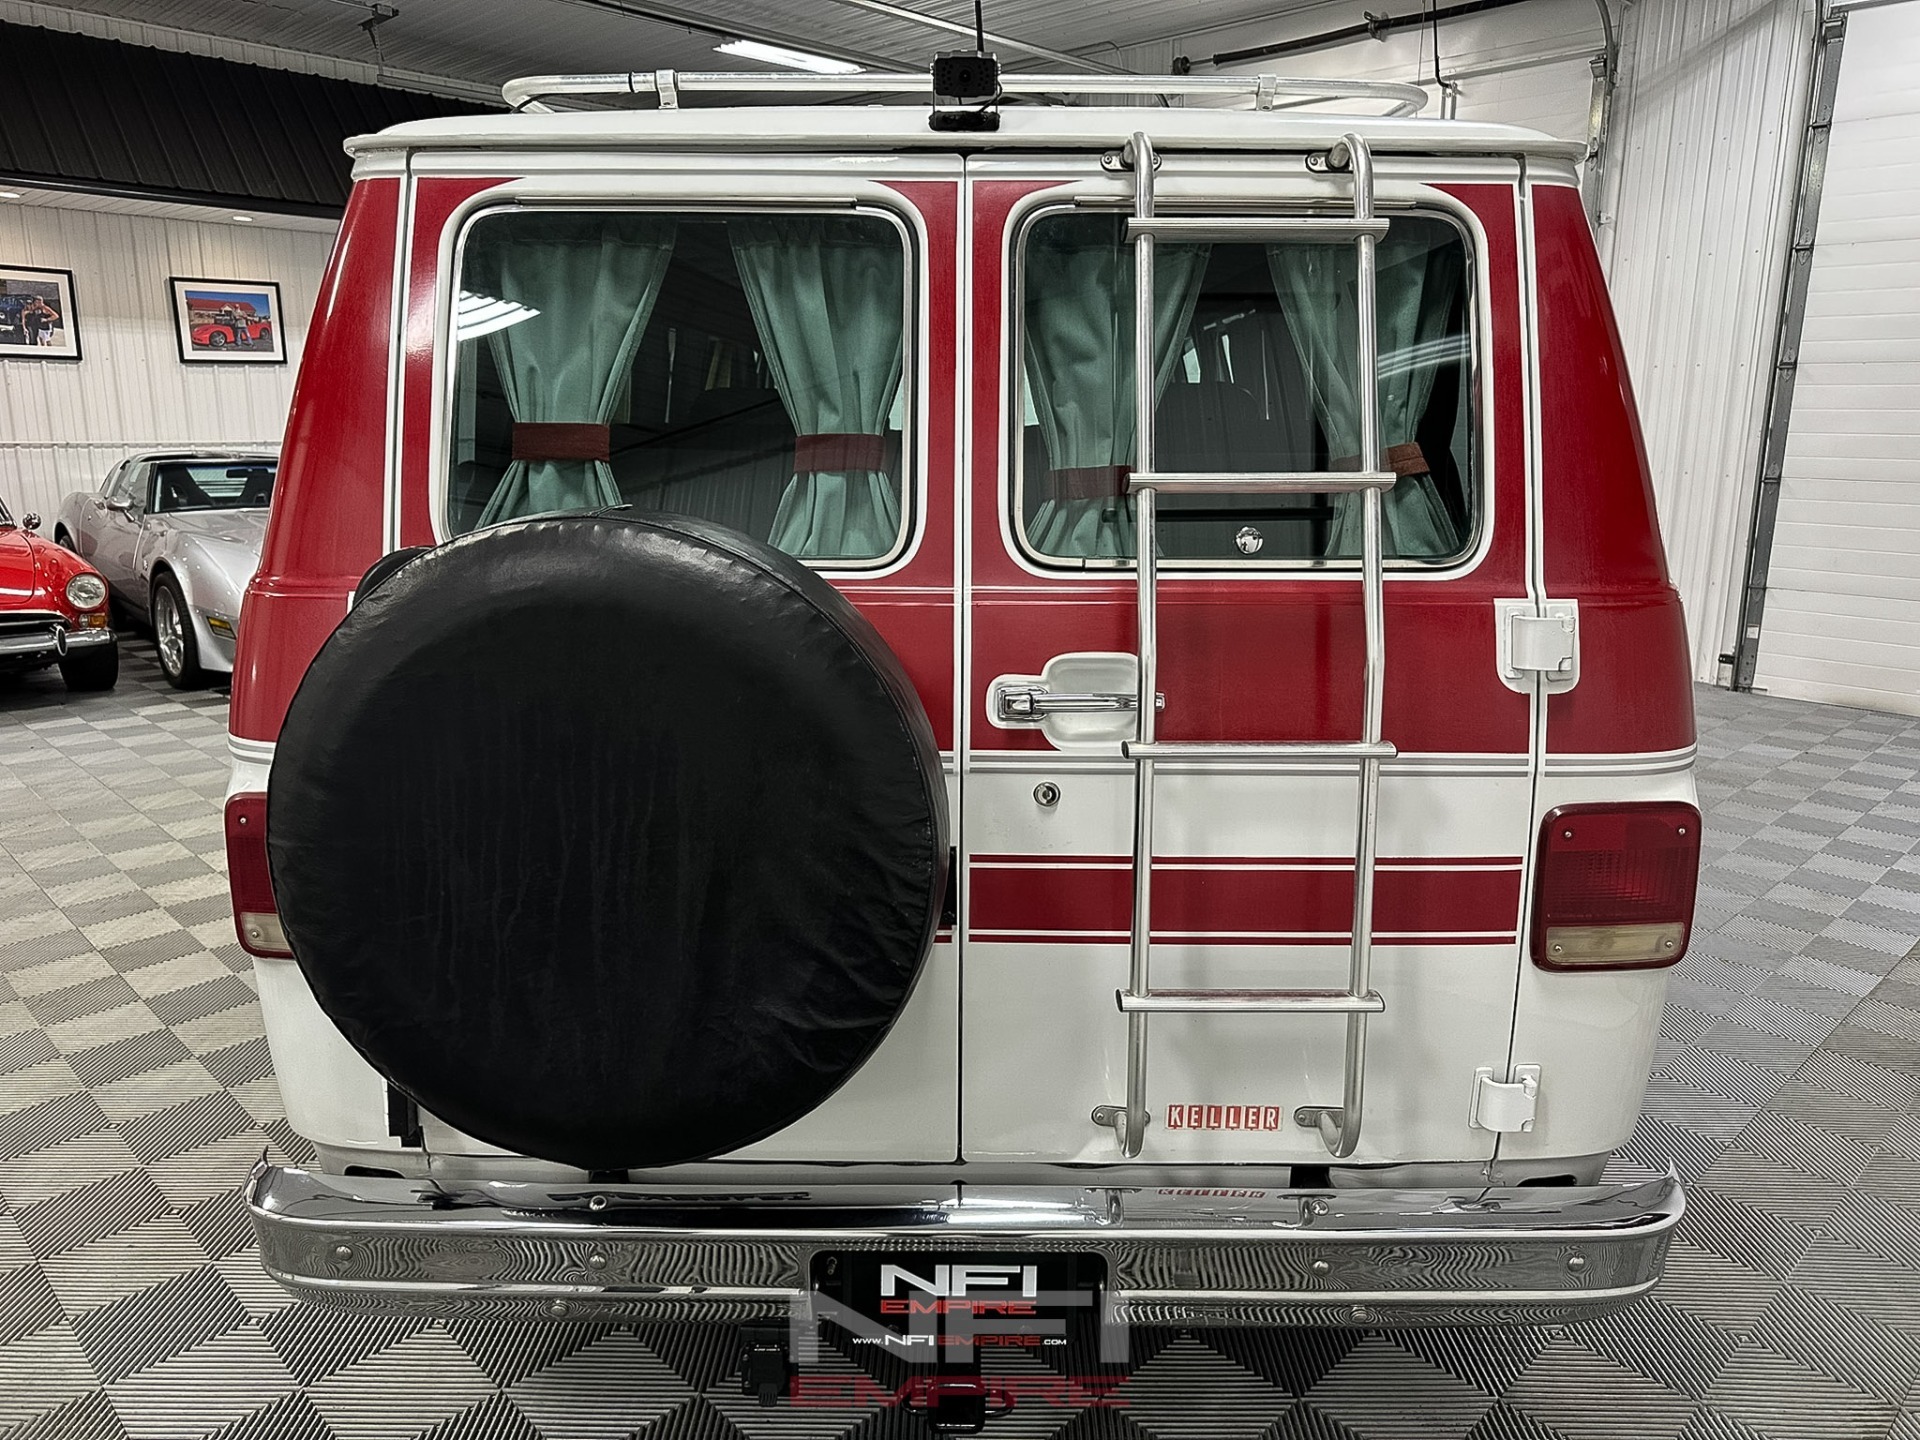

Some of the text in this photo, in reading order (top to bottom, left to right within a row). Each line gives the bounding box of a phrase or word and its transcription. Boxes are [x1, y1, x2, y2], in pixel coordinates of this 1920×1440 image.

[1168, 1105, 1280, 1130] KELLER
[880, 1264, 1038, 1298] NFI
[880, 1299, 1037, 1315] EMPIRE
